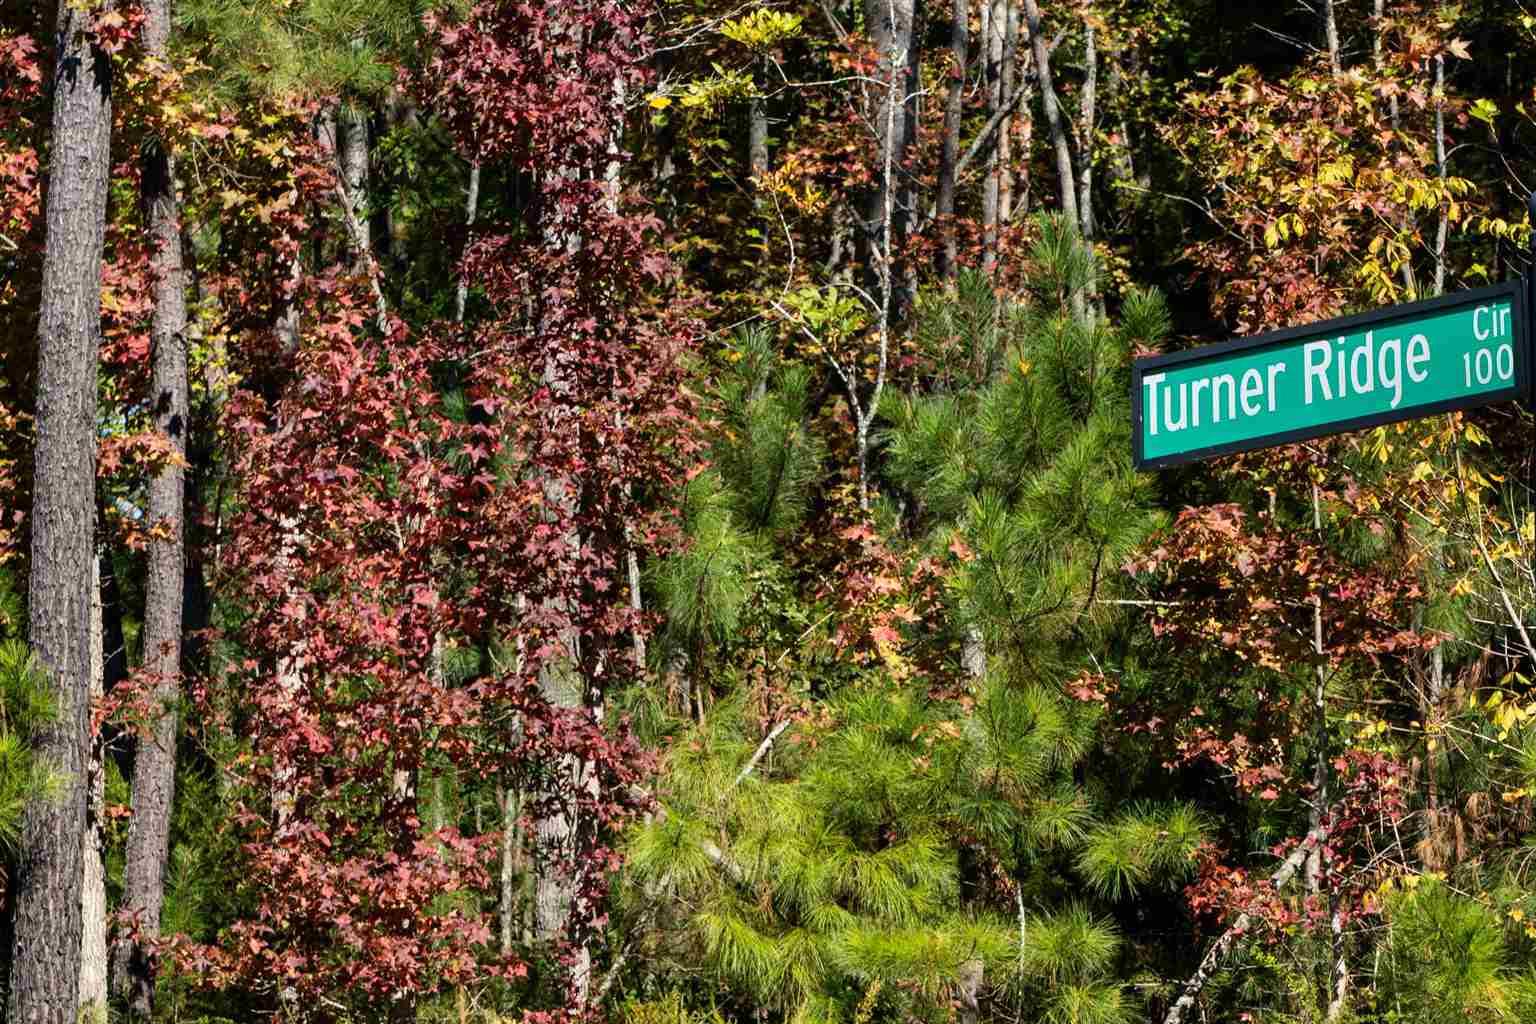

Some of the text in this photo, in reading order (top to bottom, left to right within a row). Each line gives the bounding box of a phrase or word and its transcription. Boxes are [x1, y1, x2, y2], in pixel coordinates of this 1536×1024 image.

[1472, 304, 1512, 341] Cir
[1143, 330, 1430, 436] Turner Ridge
[1463, 343, 1514, 388] 100
